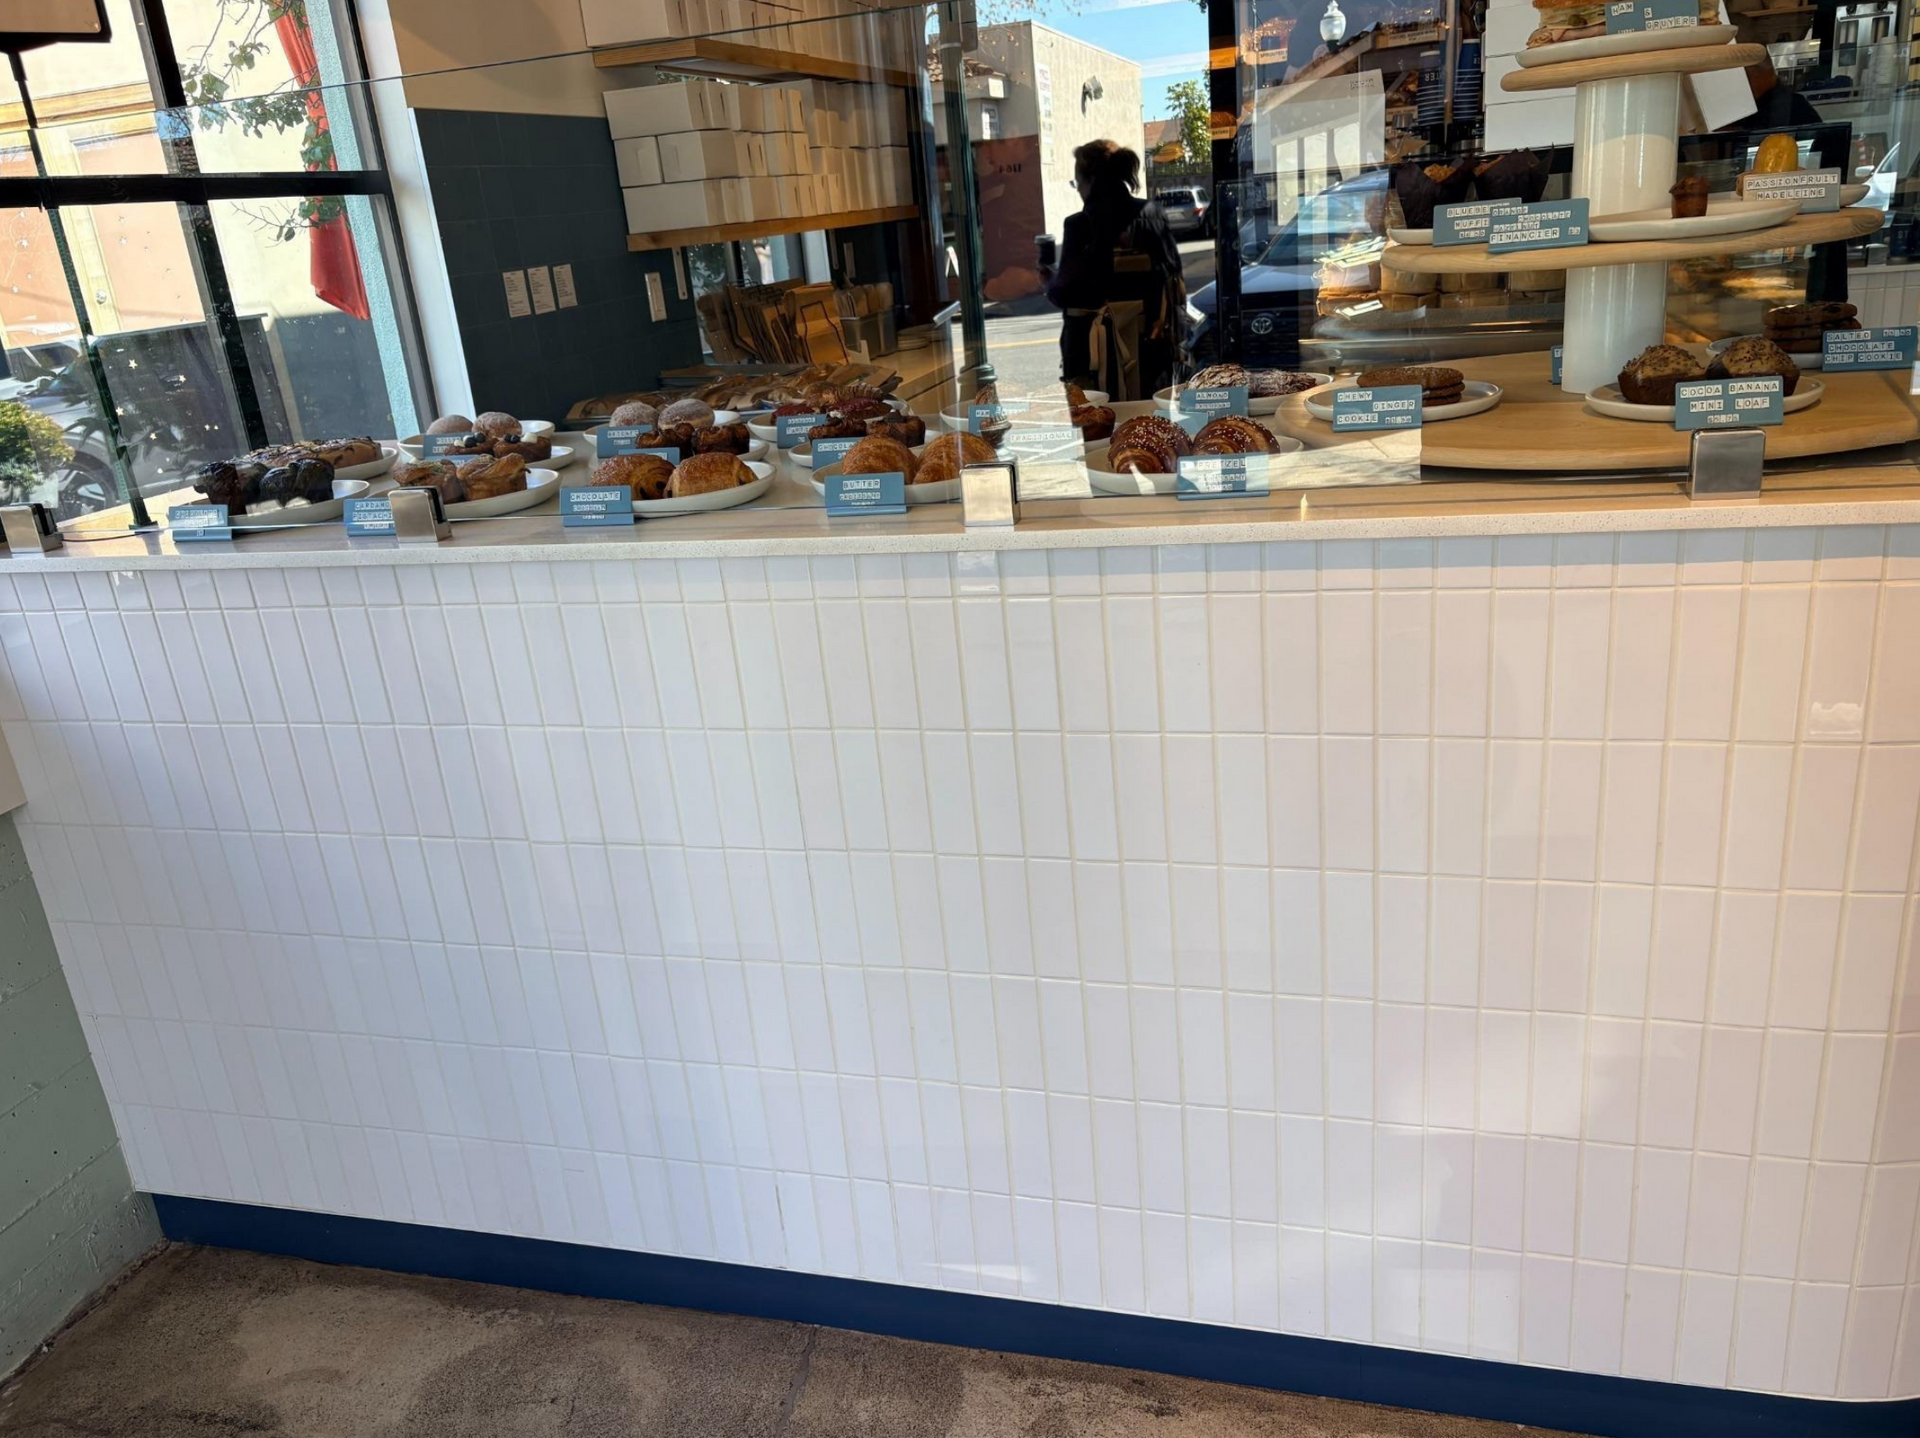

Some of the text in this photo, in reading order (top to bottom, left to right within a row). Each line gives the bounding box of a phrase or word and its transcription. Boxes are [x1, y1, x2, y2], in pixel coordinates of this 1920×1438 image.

[1611, 2, 1633, 15] HAM
[1645, 17, 1697, 30] GRUYERE
[1746, 174, 1838, 189] PASSIONFRUIT
[1757, 188, 1825, 200] MADELEINE
[1447, 205, 1491, 217] BLUEBE
[1454, 218, 1490, 230] MUFFI
[1490, 228, 1559, 244] FINANCIER
[1827, 331, 1871, 342] SALTED
[1828, 341, 1895, 353] CHOCOLATE
[1825, 352, 1902, 363] CHIP COOKIE
[1680, 381, 1779, 398] COCOA BANANA
[1196, 392, 1228, 400] ALMOND
[1337, 391, 1372, 402] CHEWY
[1373, 400, 1415, 411] GINGER
[1690, 397, 1769, 412] MINI LOAF
[1337, 413, 1378, 424] COOKIE
[818, 442, 854, 451] CHOCOLA
[1197, 459, 1246, 470] PRETZEL
[843, 479, 880, 490] BUTTER
[570, 491, 621, 501] CHOCOLATE
[355, 501, 391, 510] CARDAMO
[352, 511, 393, 520] PISTACHI
